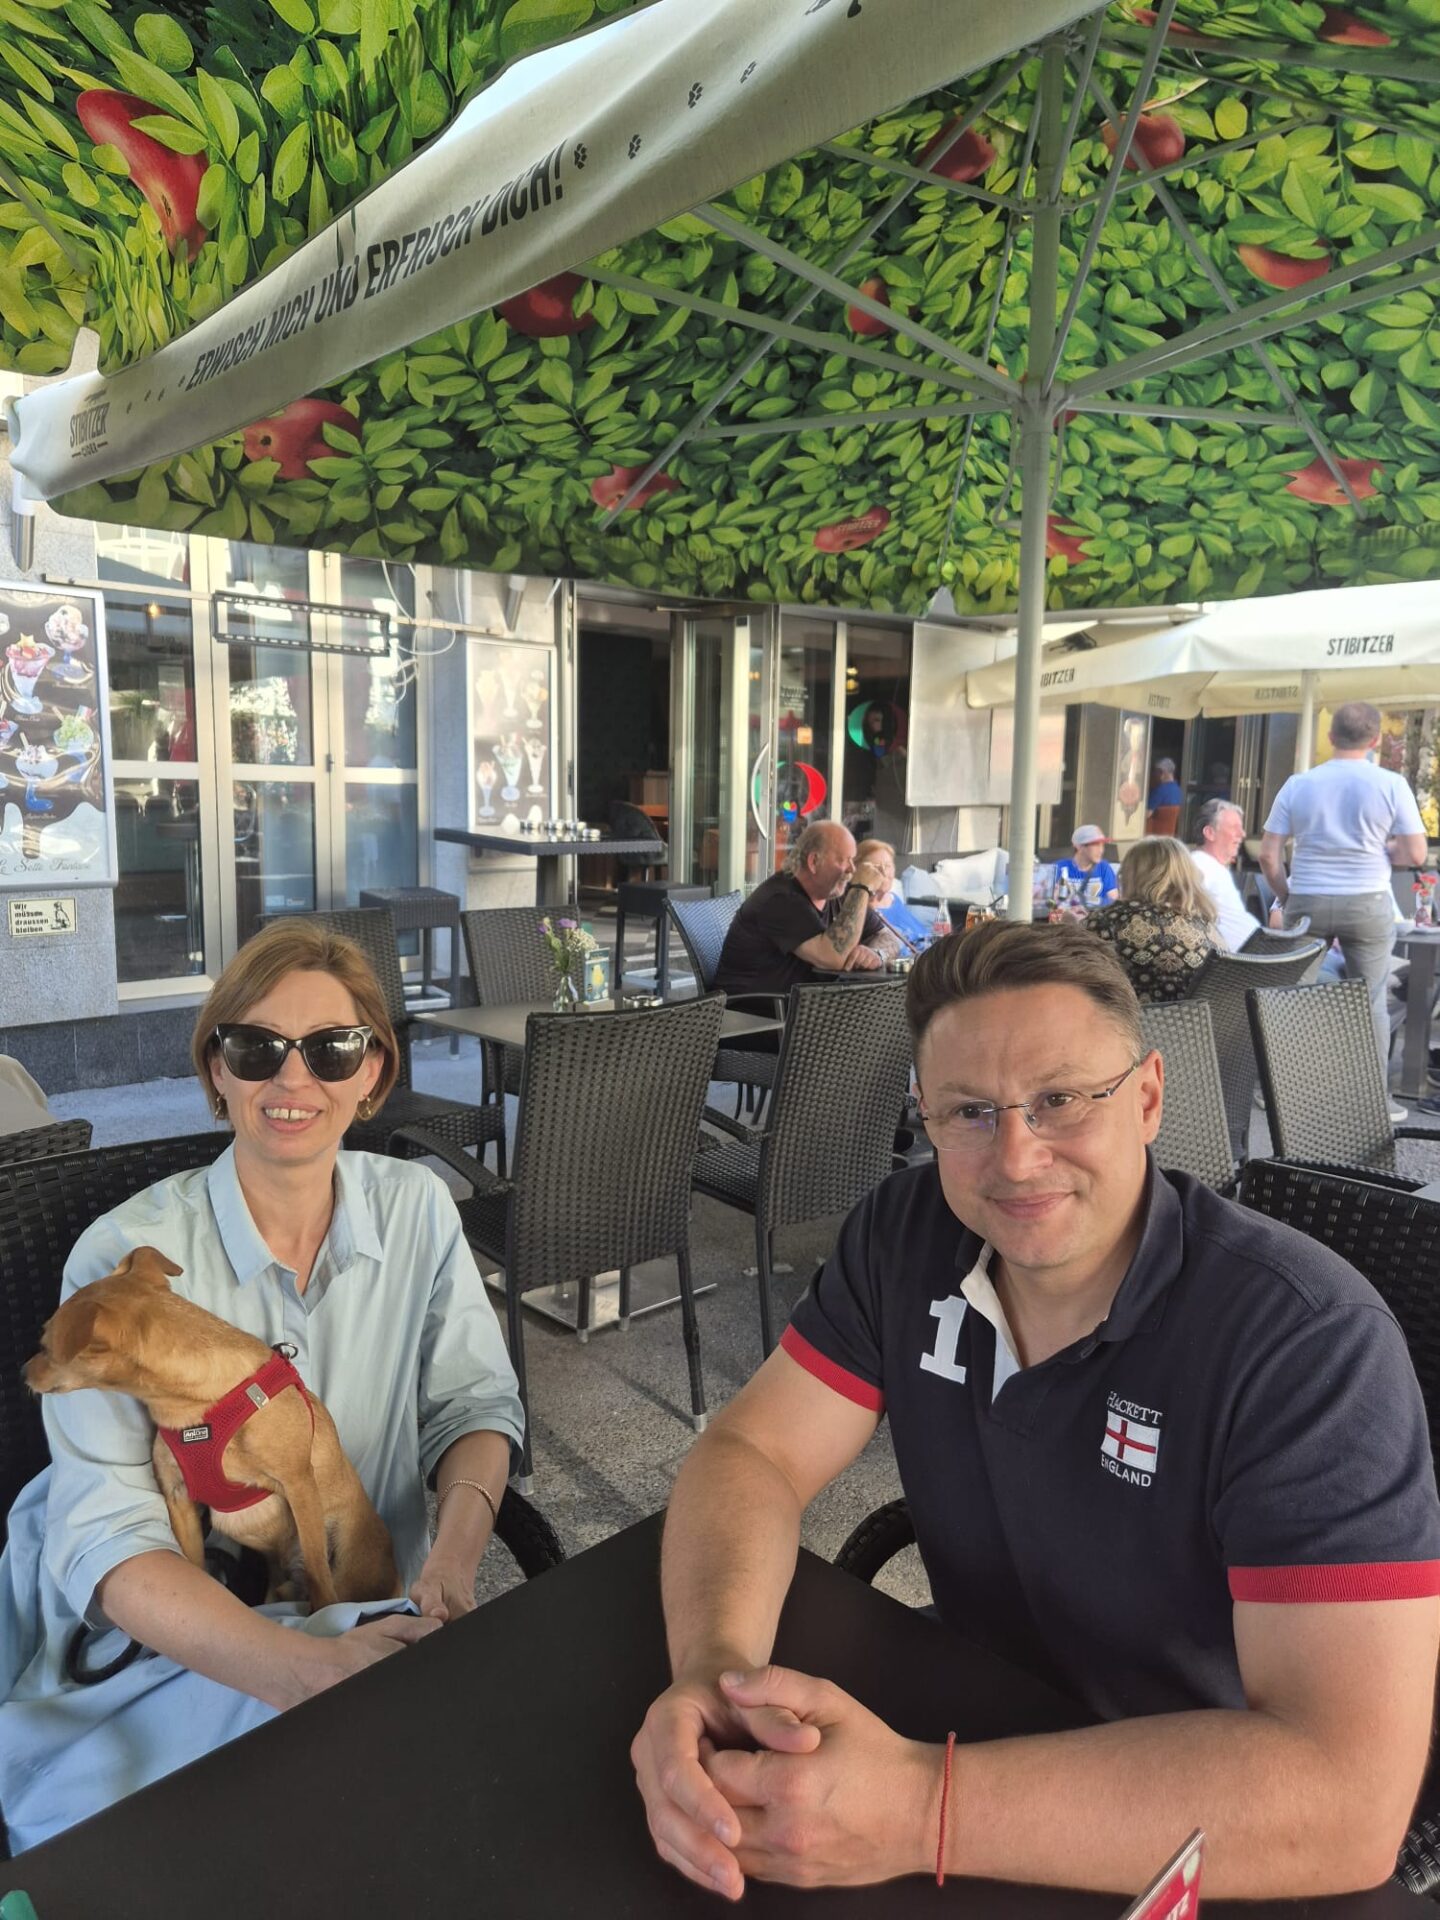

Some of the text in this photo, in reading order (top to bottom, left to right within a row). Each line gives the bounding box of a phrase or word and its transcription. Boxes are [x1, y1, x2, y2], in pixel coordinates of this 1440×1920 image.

[185, 139, 567, 391] ERWISCH MICH UND ERFRISCH DICH!
[1327, 634, 1394, 656] STIBITZER
[1040, 668, 1075, 688] IBITZER
[920, 1294, 967, 1385] 1
[1107, 1391, 1163, 1425] HACKETT
[1101, 1454, 1151, 1487] ENGLAND
